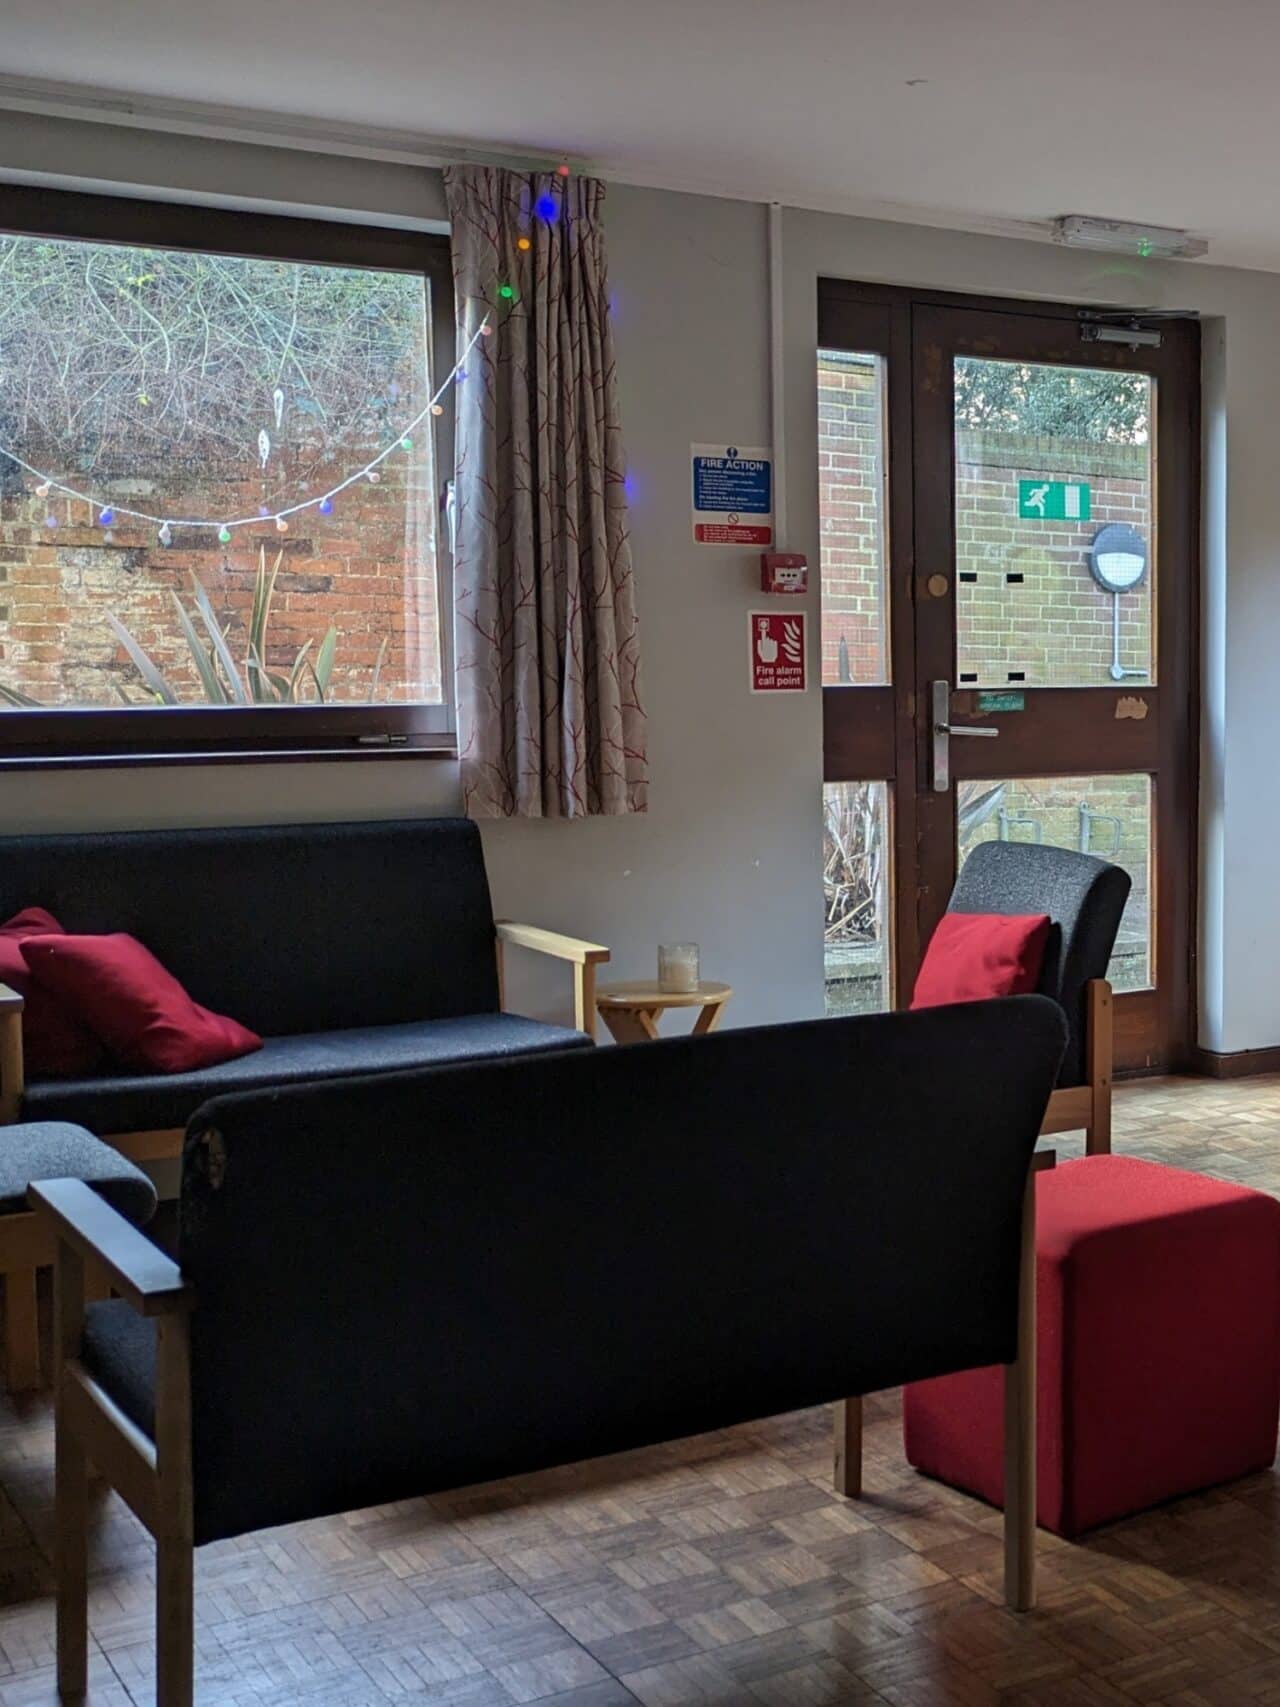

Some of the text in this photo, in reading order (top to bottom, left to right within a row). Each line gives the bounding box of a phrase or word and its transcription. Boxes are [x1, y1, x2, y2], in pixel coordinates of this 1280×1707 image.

[700, 458, 764, 471] FIRE ACTION
[756, 665, 802, 675] Fire alarm
[758, 676, 801, 687] call point
